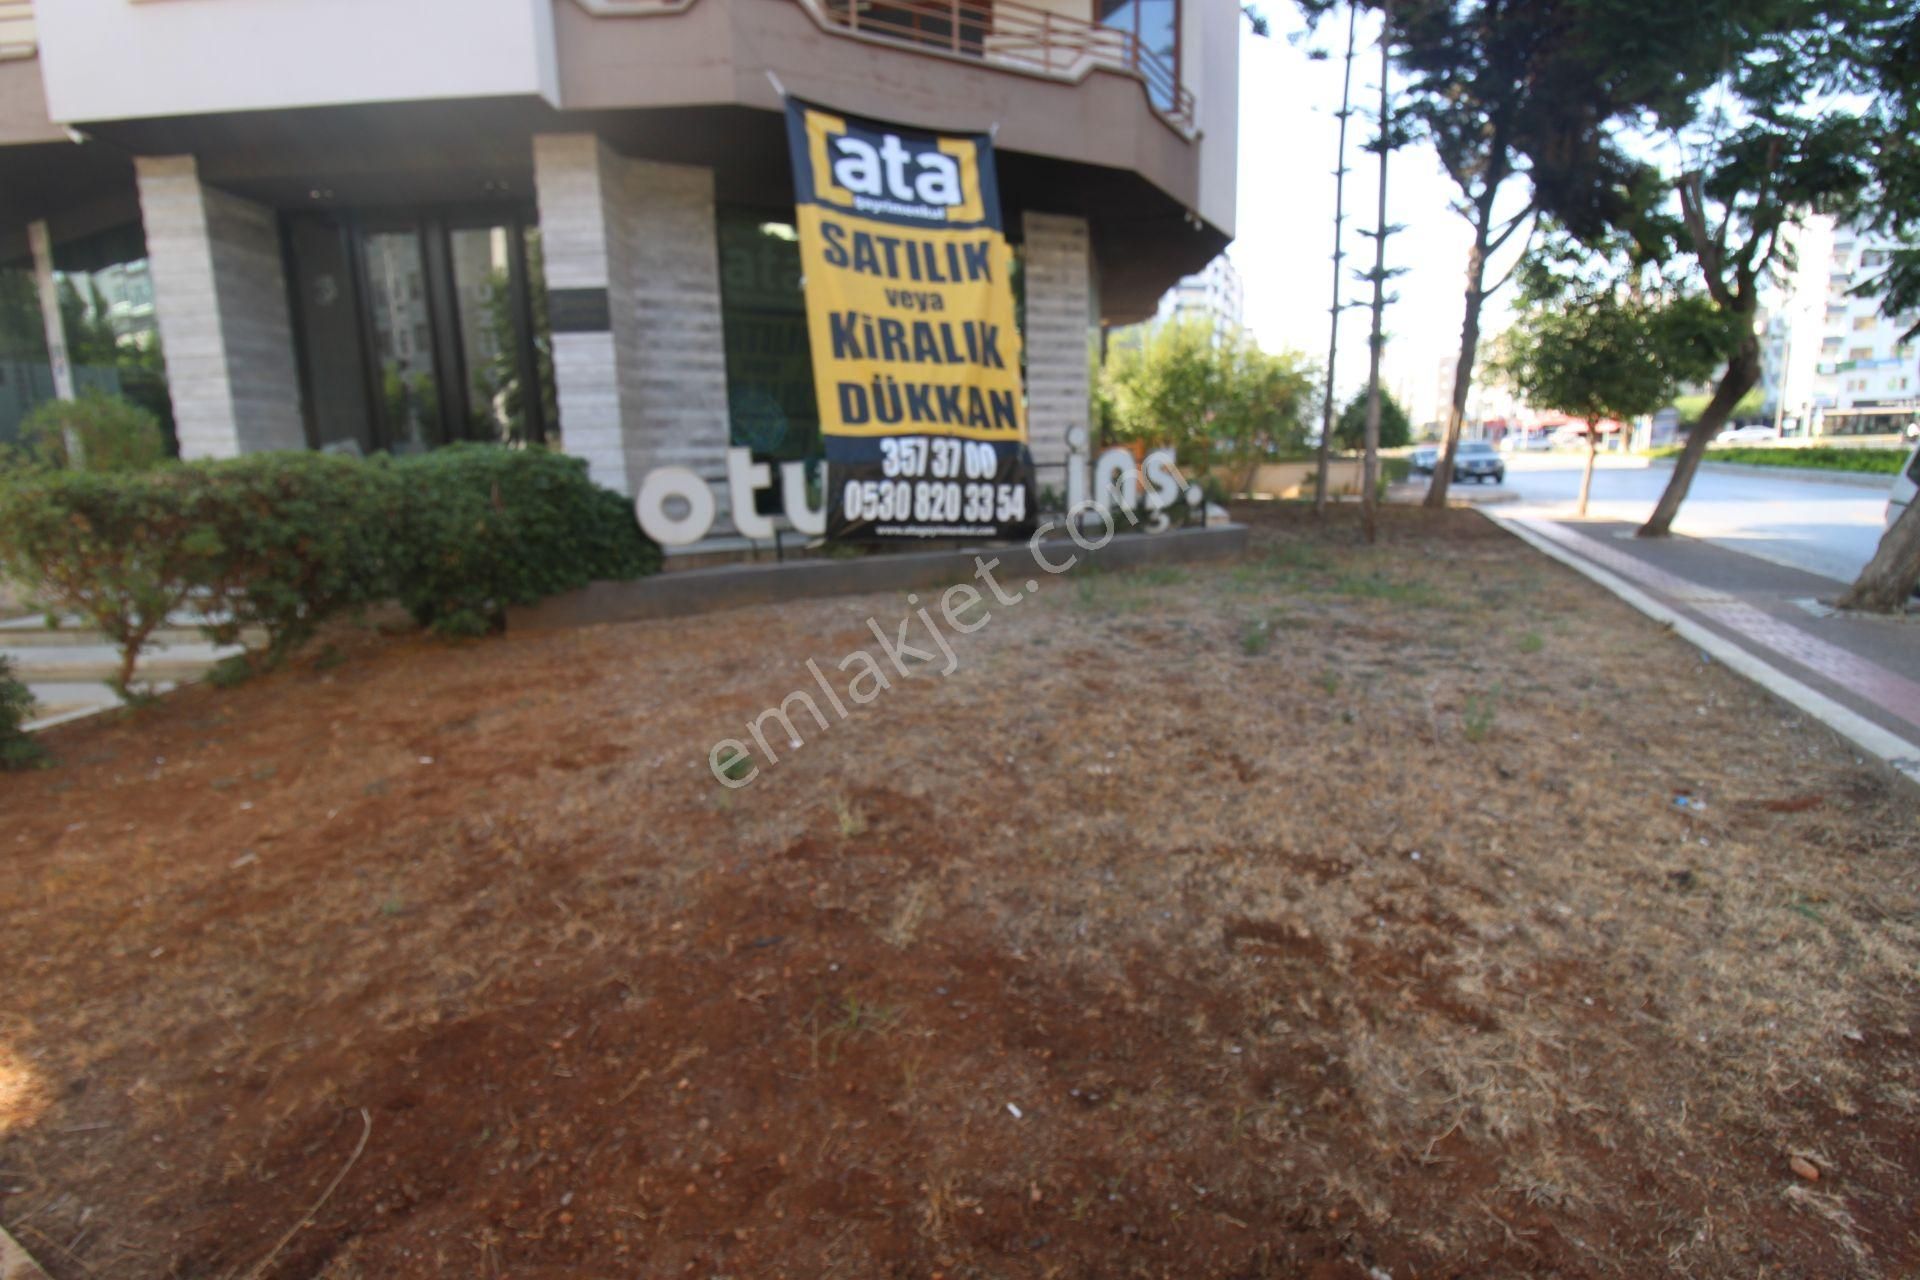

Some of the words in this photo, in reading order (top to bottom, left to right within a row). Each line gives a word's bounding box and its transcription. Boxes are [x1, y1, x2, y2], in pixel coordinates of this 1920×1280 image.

[834, 134, 963, 205] ata
[820, 221, 993, 284] SATILIK
[885, 288, 944, 313] veya
[837, 374, 1019, 429] DÜKKAN
[880, 437, 930, 477] 357
[931, 438, 962, 478] 37
[964, 441, 998, 479] 00
[843, 480, 912, 521] 0530
[914, 481, 962, 522] 820
[963, 482, 996, 522] 33
[995, 484, 1026, 522] 54
